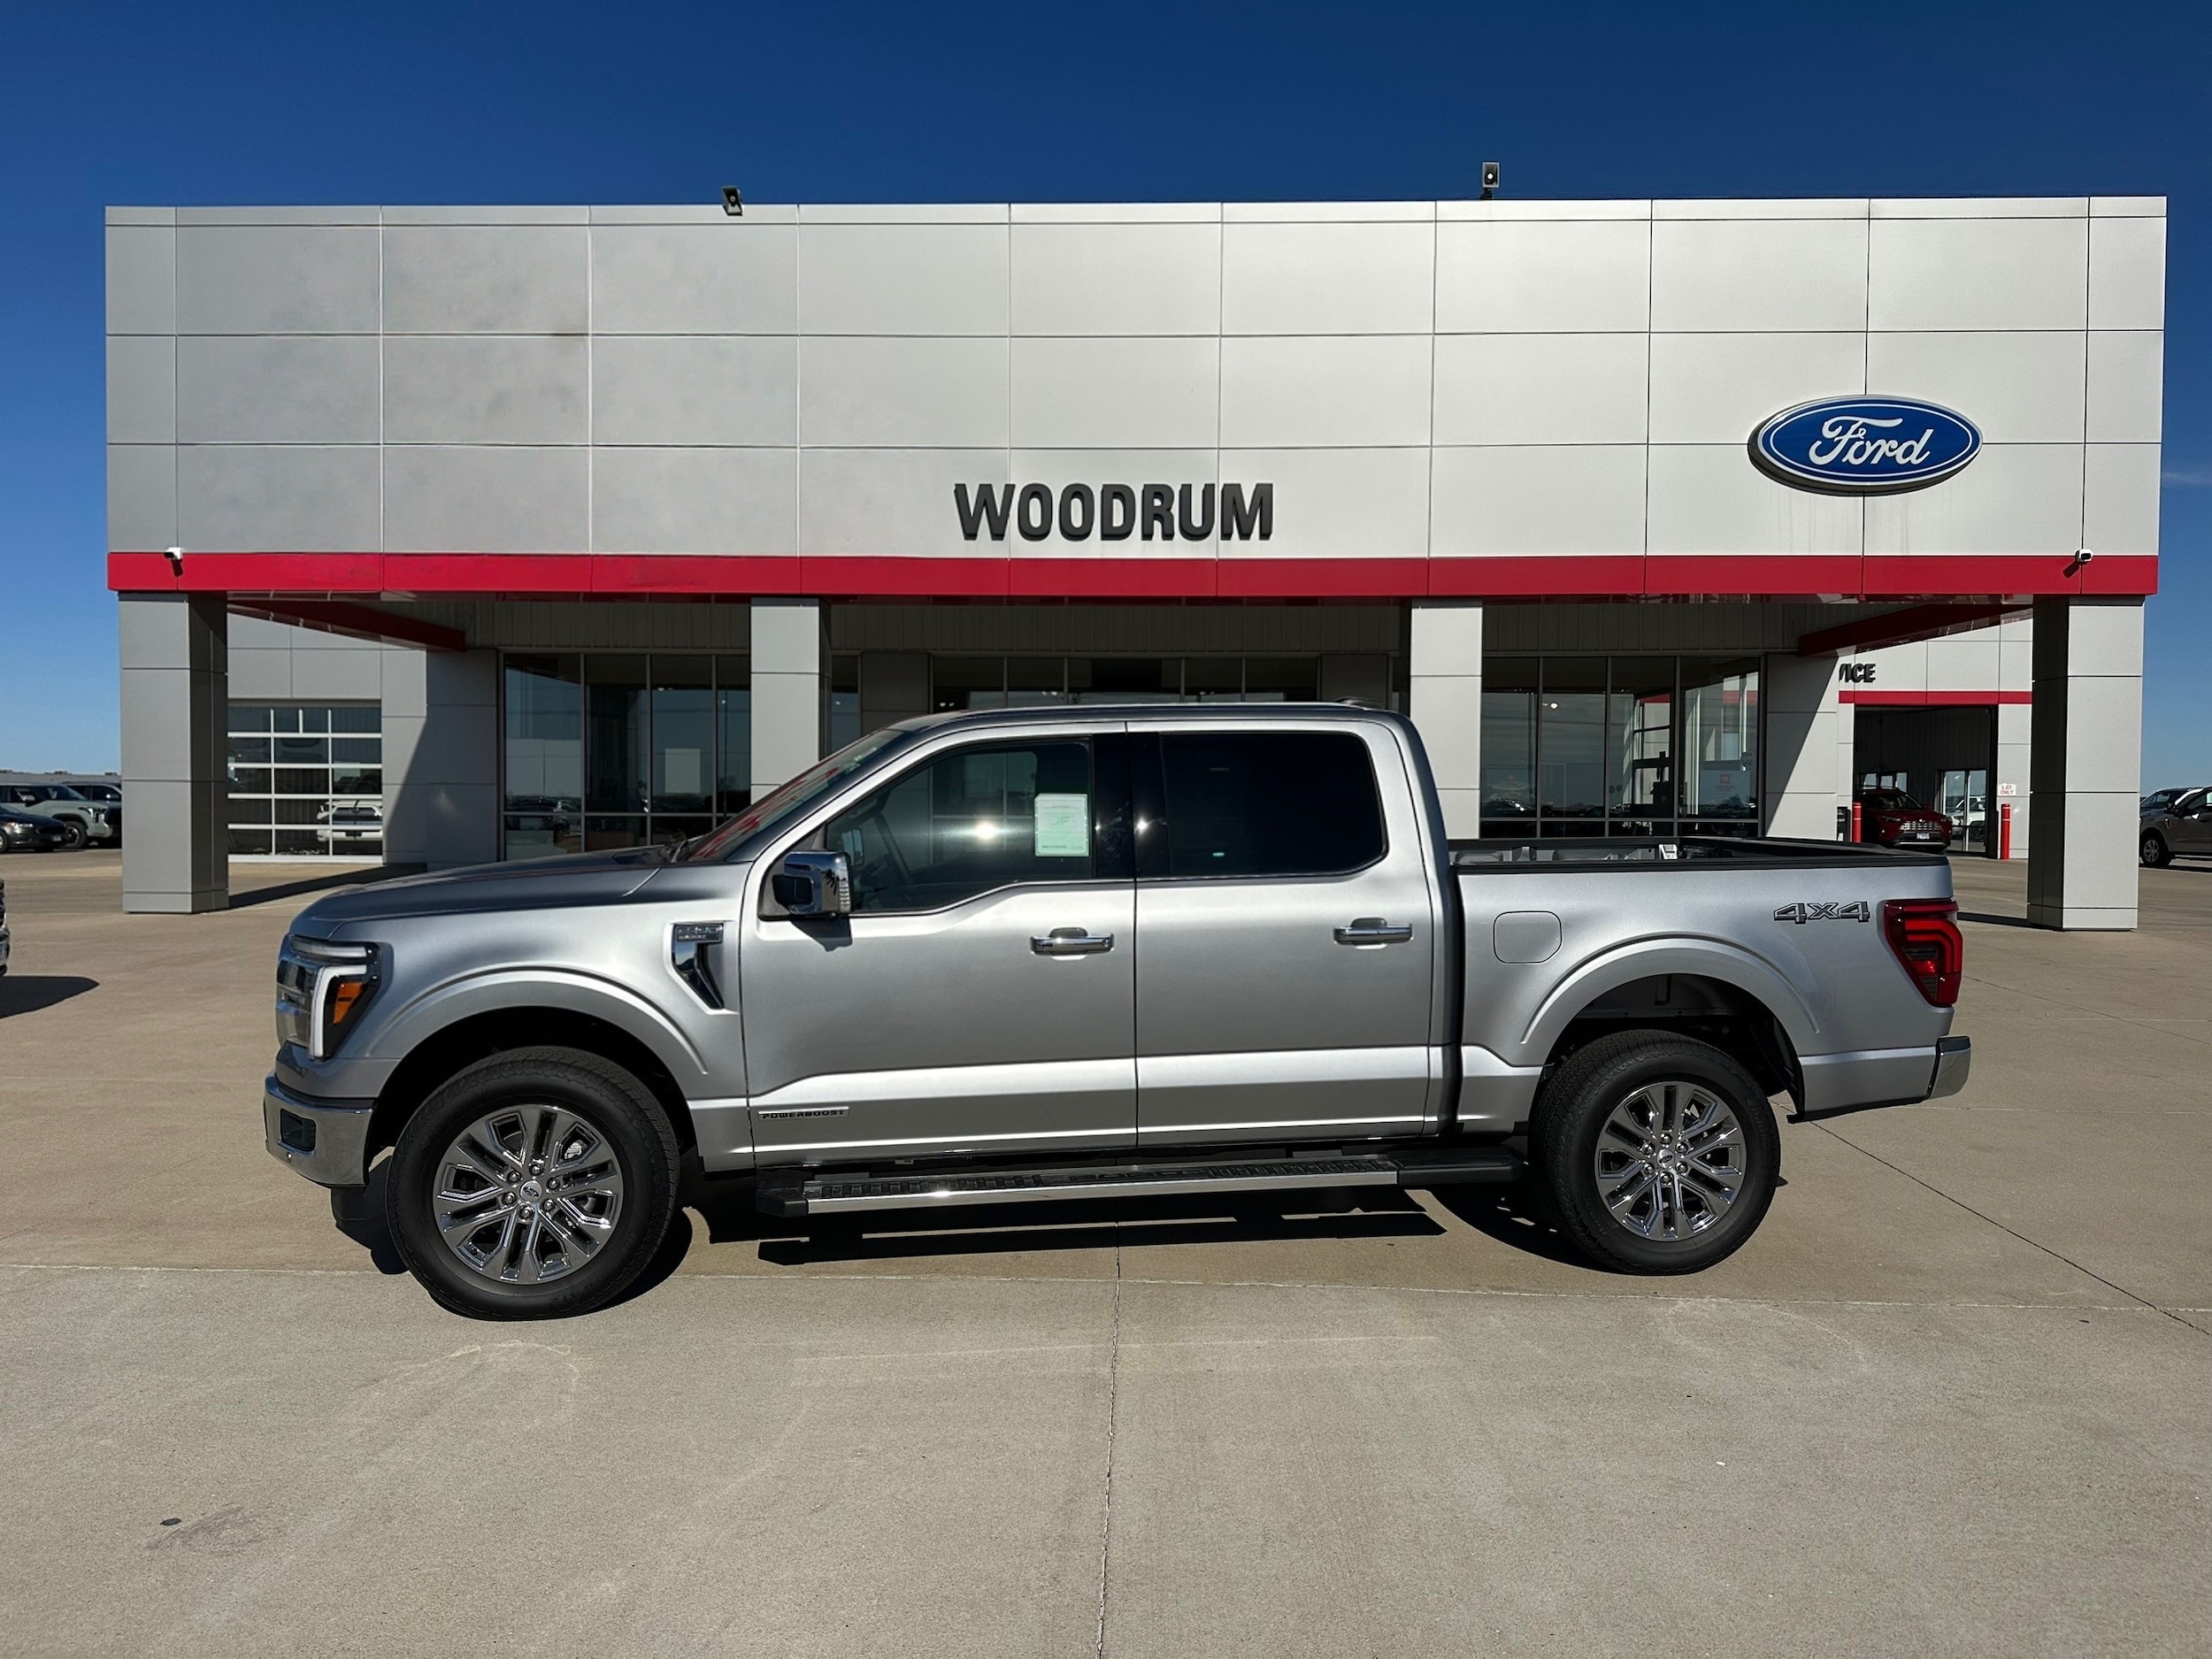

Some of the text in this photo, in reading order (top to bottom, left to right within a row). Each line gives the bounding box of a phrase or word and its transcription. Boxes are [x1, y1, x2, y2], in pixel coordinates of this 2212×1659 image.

[1809, 415, 1933, 465] Ford
[954, 483, 1273, 541] WOODRUM
[762, 1110, 845, 1119] POWERBOOST
